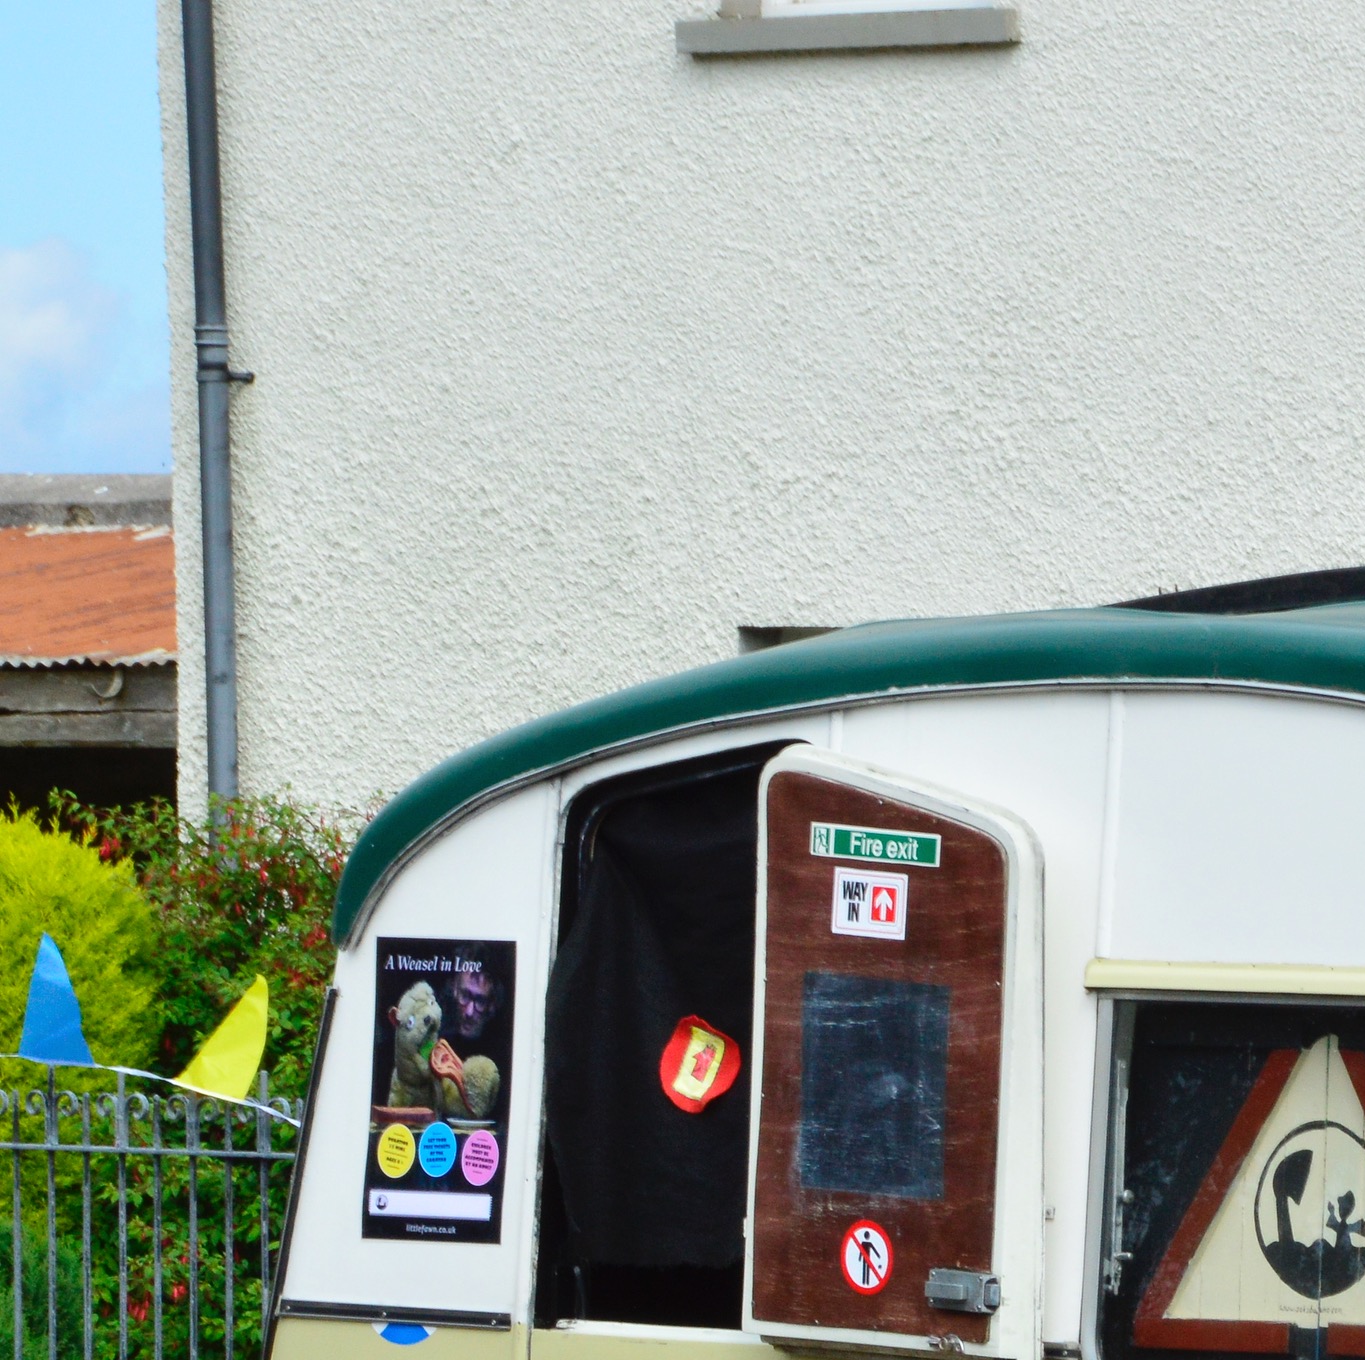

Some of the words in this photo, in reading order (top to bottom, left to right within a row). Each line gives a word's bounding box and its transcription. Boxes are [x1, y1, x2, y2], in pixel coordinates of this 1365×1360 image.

[850, 832, 883, 857] Fire
[886, 837, 919, 860] exit
[843, 880, 868, 902] WAY
[848, 902, 860, 922] IN
[385, 955, 394, 970] A
[397, 955, 438, 971] Weasel
[440, 956, 452, 972] in
[455, 956, 482, 972] Love
